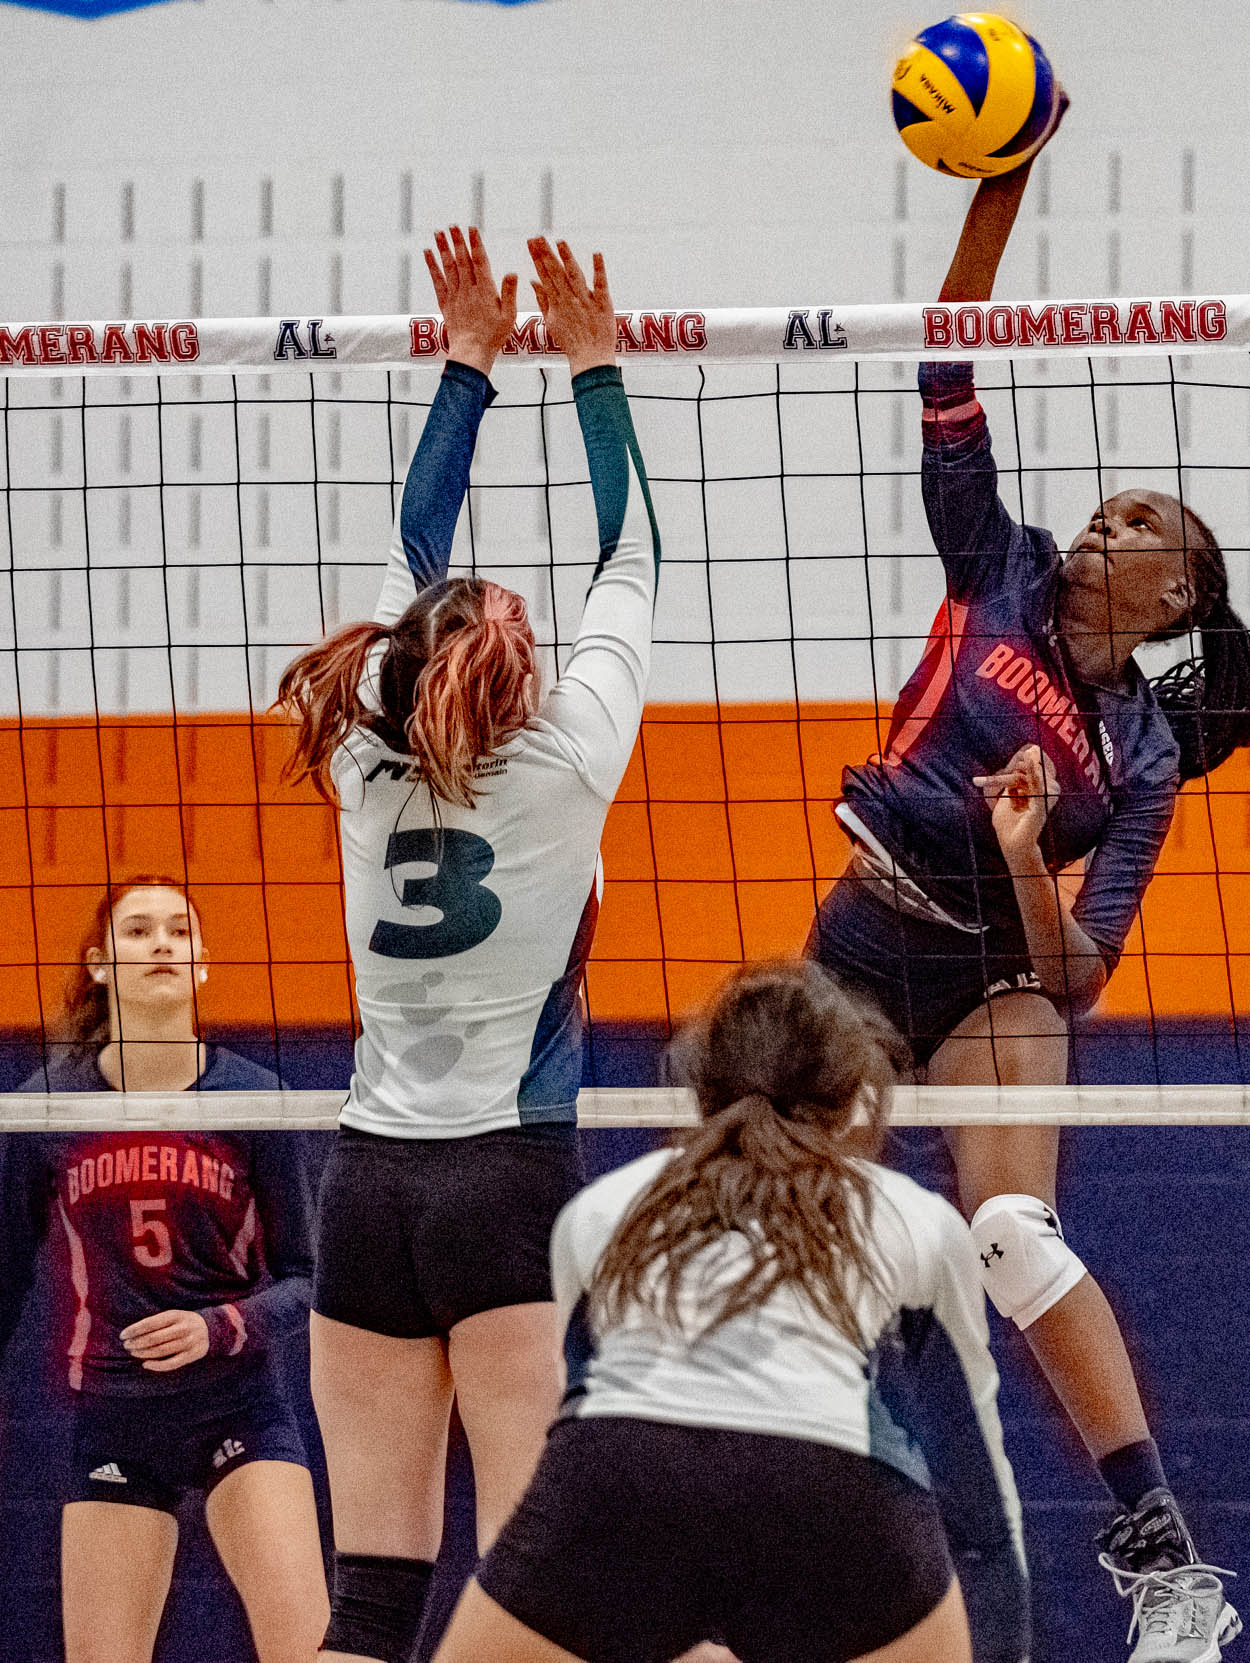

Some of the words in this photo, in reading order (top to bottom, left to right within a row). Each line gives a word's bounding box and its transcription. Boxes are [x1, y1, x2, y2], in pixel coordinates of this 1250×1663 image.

[922, 300, 1228, 349] BOOMERANG
[368, 827, 503, 960] 3
[67, 1145, 236, 1205] BOOMERANG
[129, 1199, 174, 1269] 5
